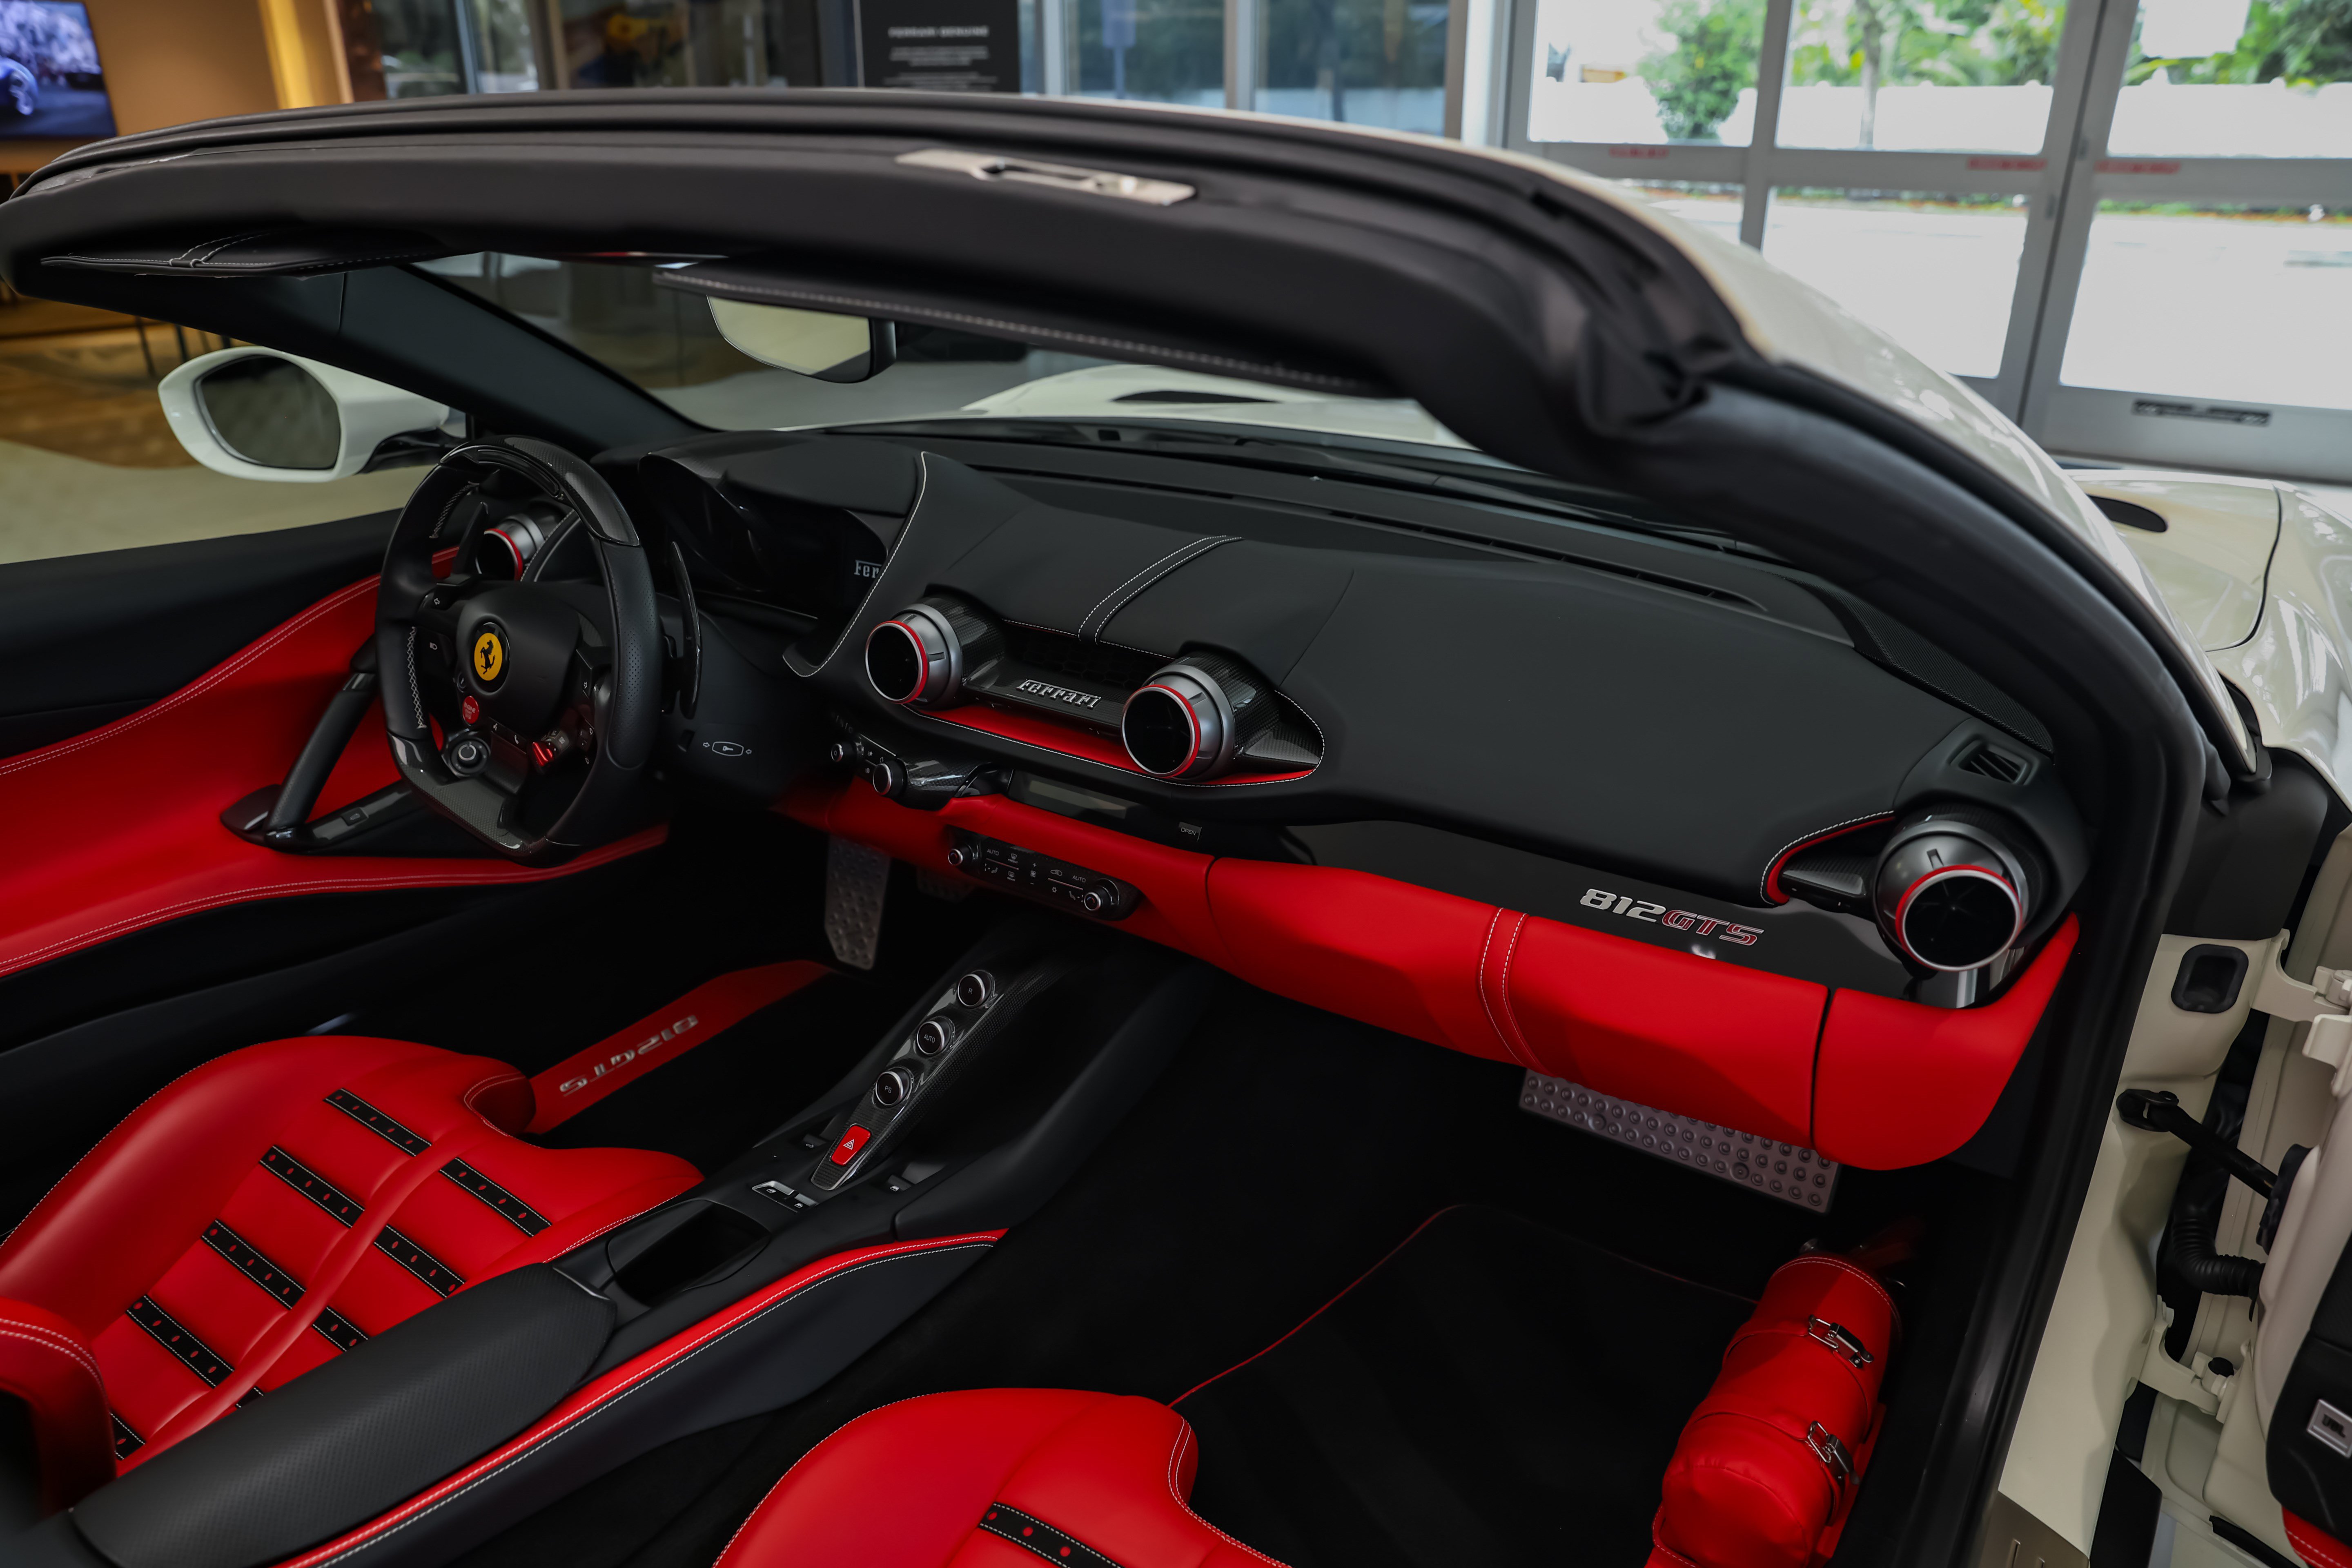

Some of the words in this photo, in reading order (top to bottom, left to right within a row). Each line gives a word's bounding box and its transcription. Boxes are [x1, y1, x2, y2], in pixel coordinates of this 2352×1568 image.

[1016, 679, 1101, 710] Ferrari
[1180, 827, 1196, 835] OPEN
[1580, 889, 1764, 946] 812GTS
[924, 1034, 935, 1043] AUTO
[885, 1085, 892, 1094] PS
